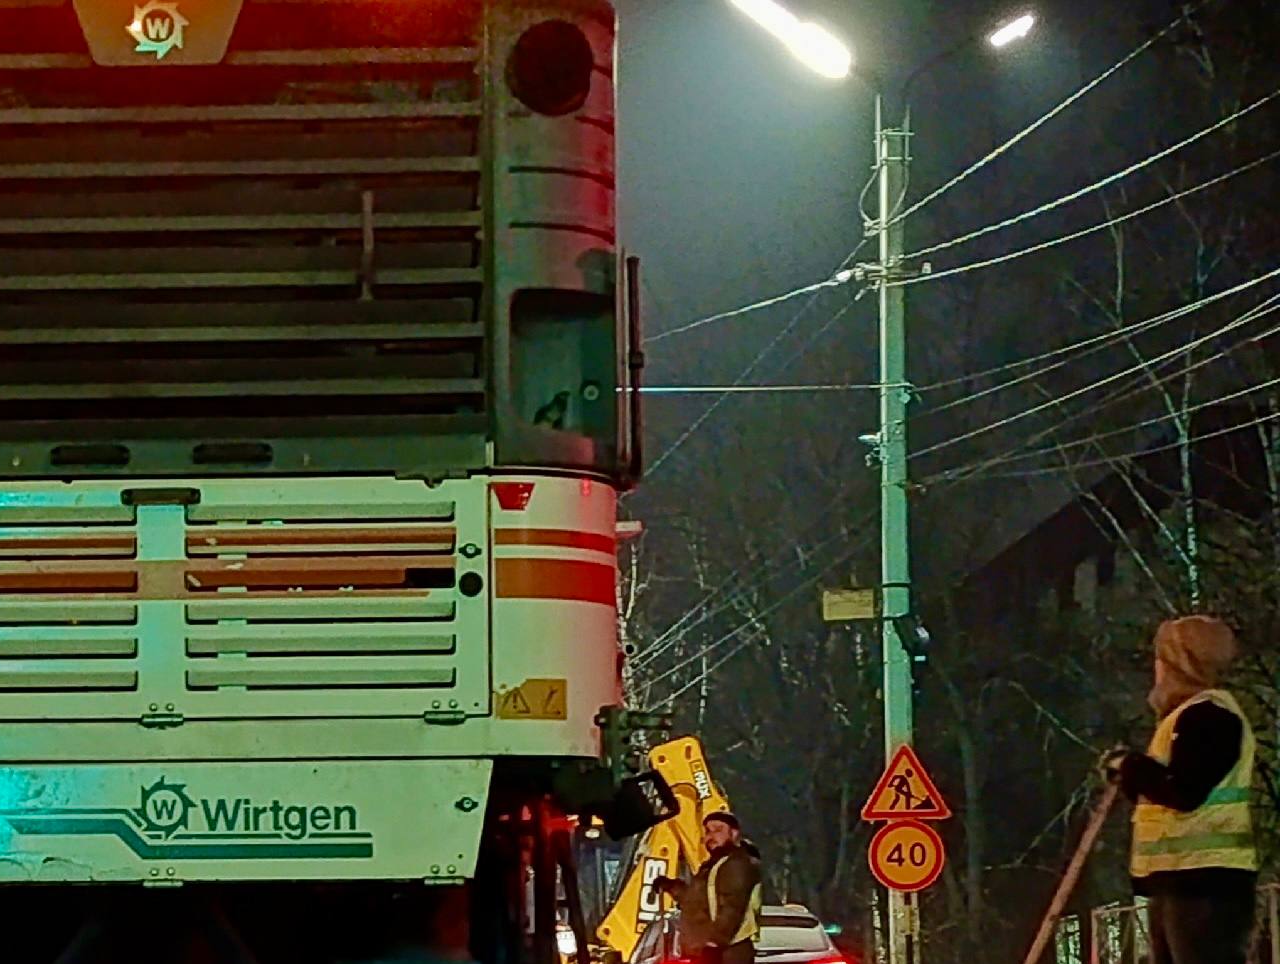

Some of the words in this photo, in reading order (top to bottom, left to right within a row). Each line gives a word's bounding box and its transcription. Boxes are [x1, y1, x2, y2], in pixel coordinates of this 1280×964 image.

[146, 17, 170, 39] W
[152, 799, 177, 820] W
[200, 798, 357, 840] Wirtgen
[886, 842, 927, 867] 40
